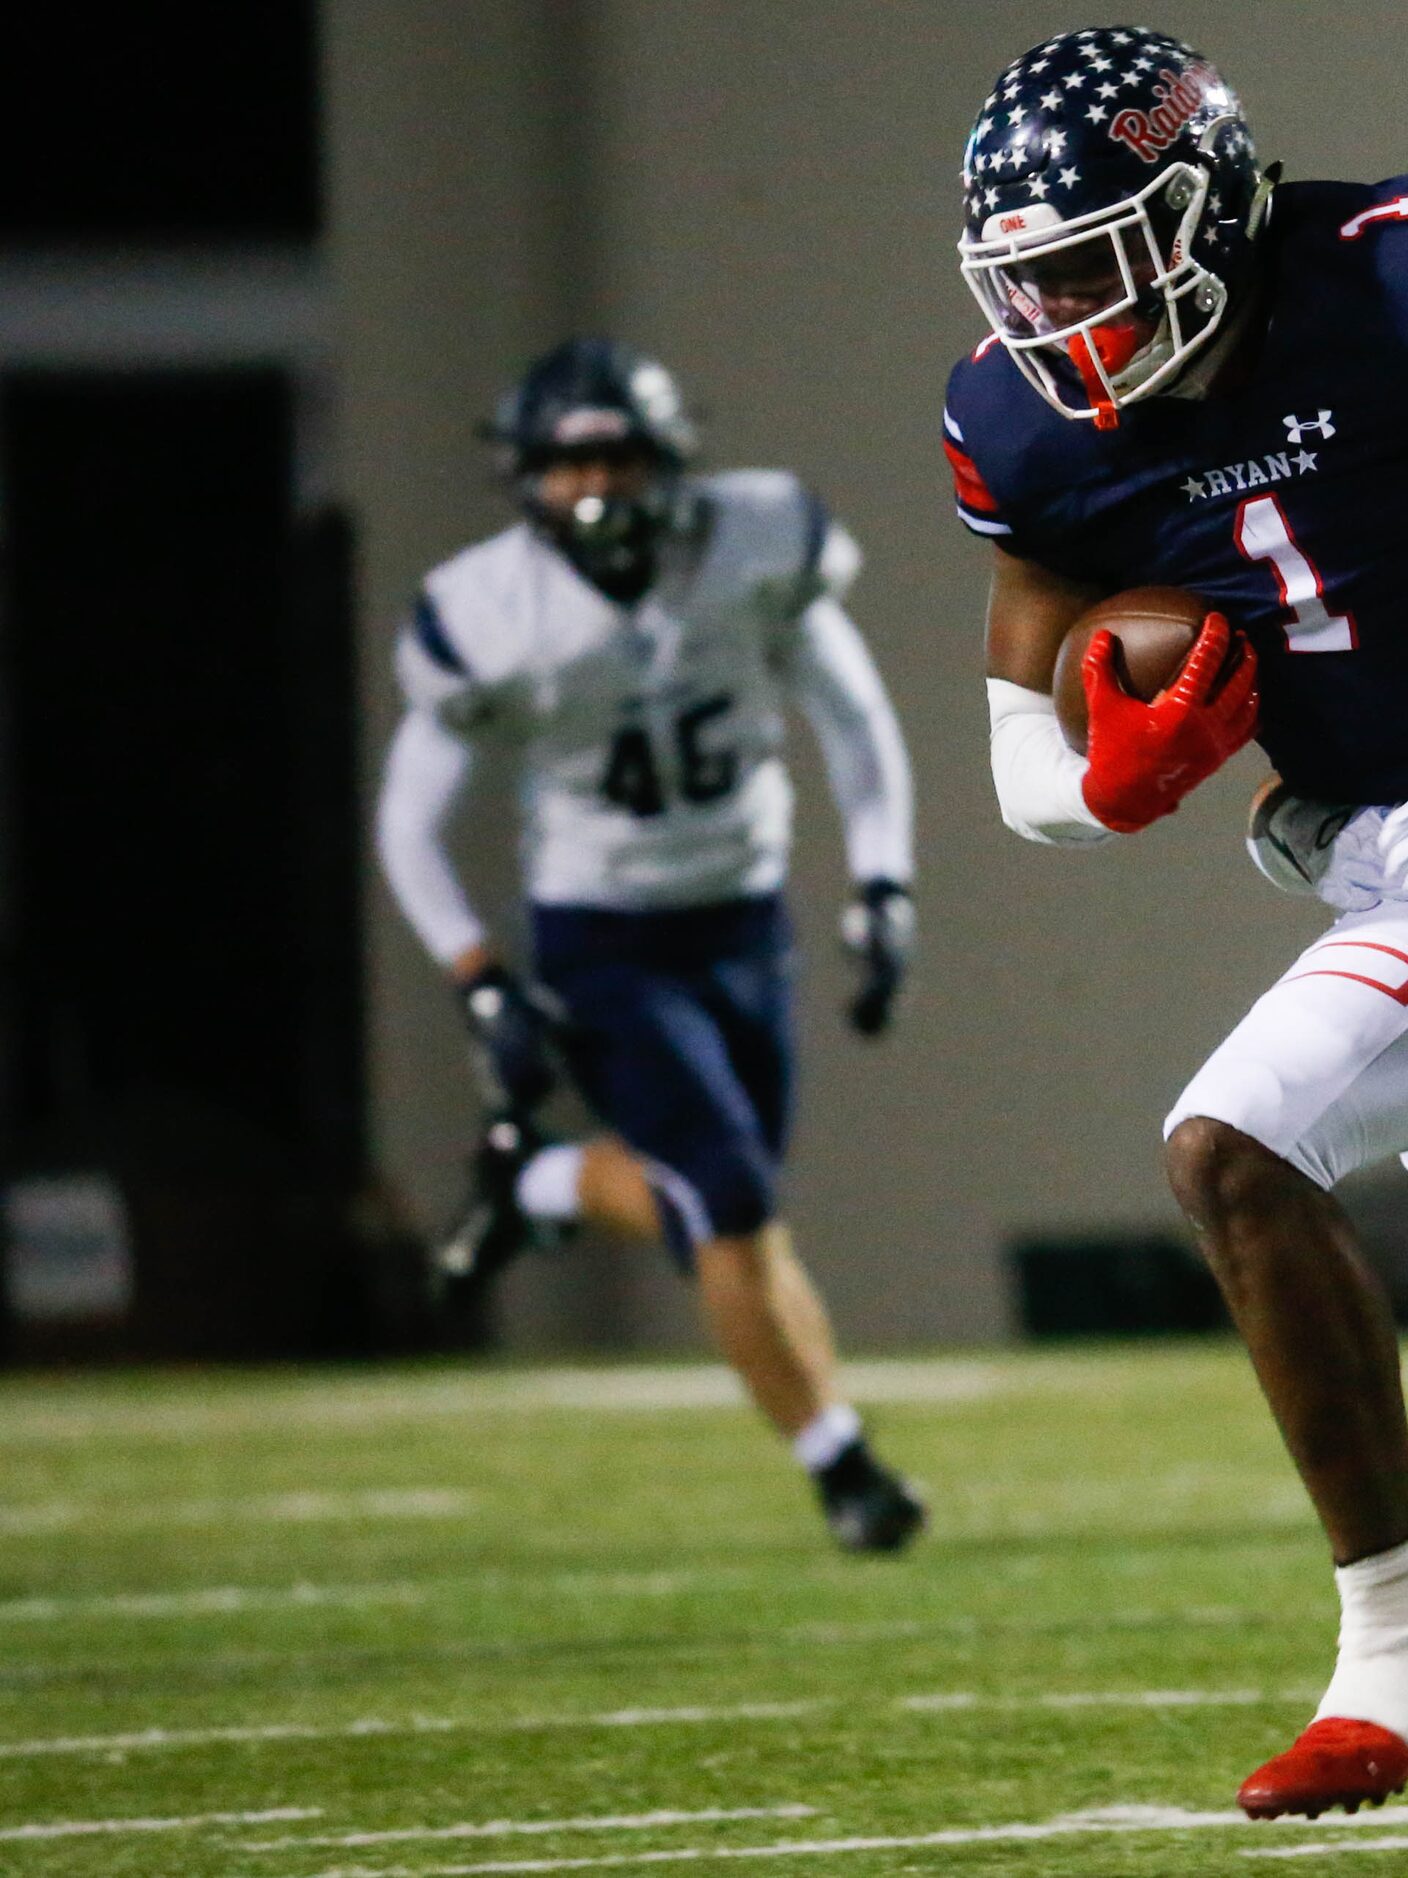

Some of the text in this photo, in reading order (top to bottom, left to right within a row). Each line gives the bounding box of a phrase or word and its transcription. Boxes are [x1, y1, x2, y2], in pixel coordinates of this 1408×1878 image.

[1000, 215, 1027, 234] ONE
[1203, 452, 1292, 497] RYAN
[1233, 491, 1360, 653] 1
[599, 691, 740, 818] 46
